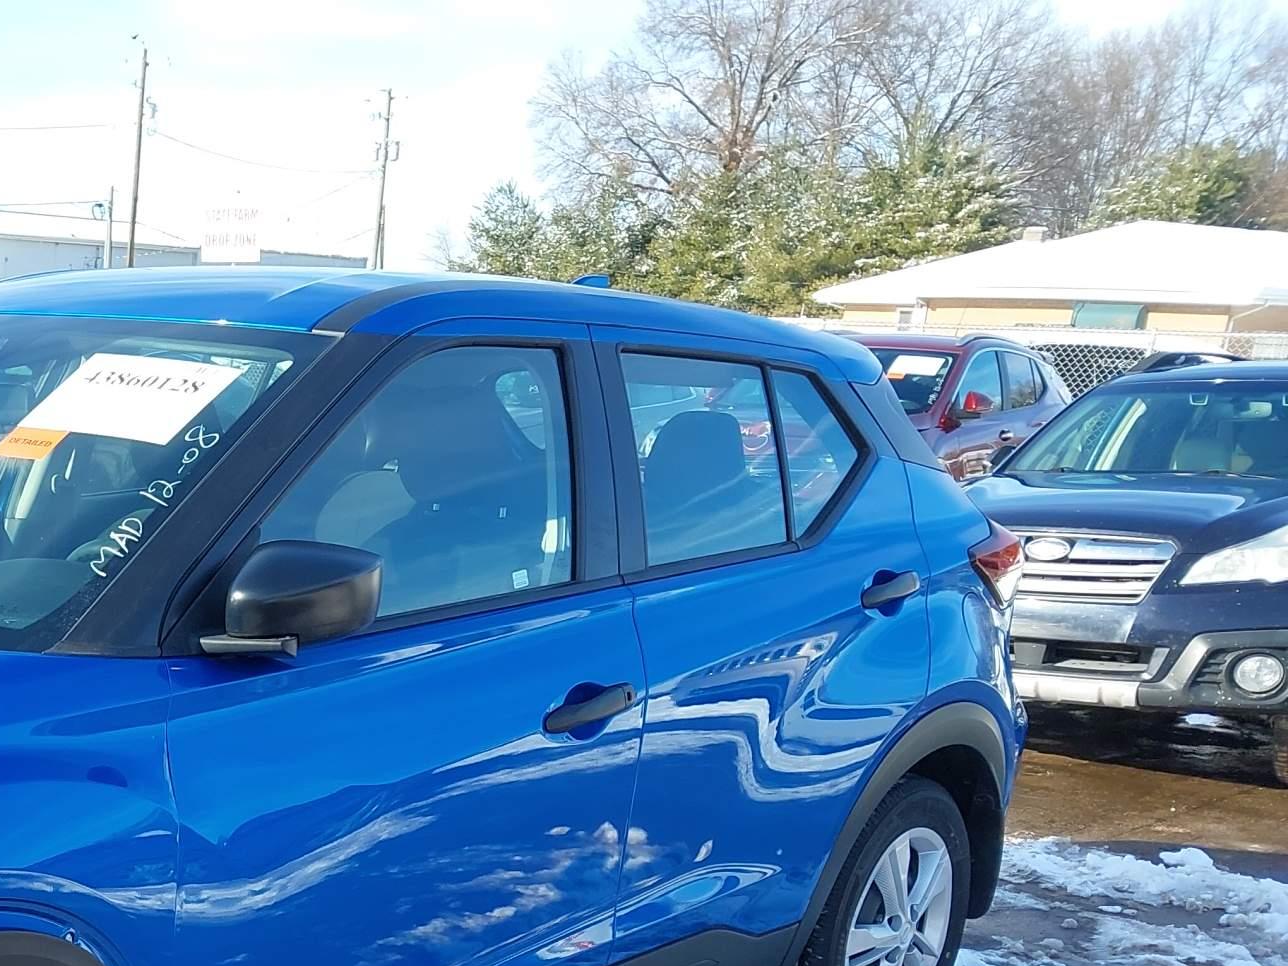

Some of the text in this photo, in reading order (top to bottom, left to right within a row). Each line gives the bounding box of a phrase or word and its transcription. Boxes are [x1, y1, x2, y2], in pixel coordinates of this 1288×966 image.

[84, 370, 205, 393] 43860128
[8, 437, 53, 448] DETAILED
[90, 424, 220, 577] MAD 12-08
